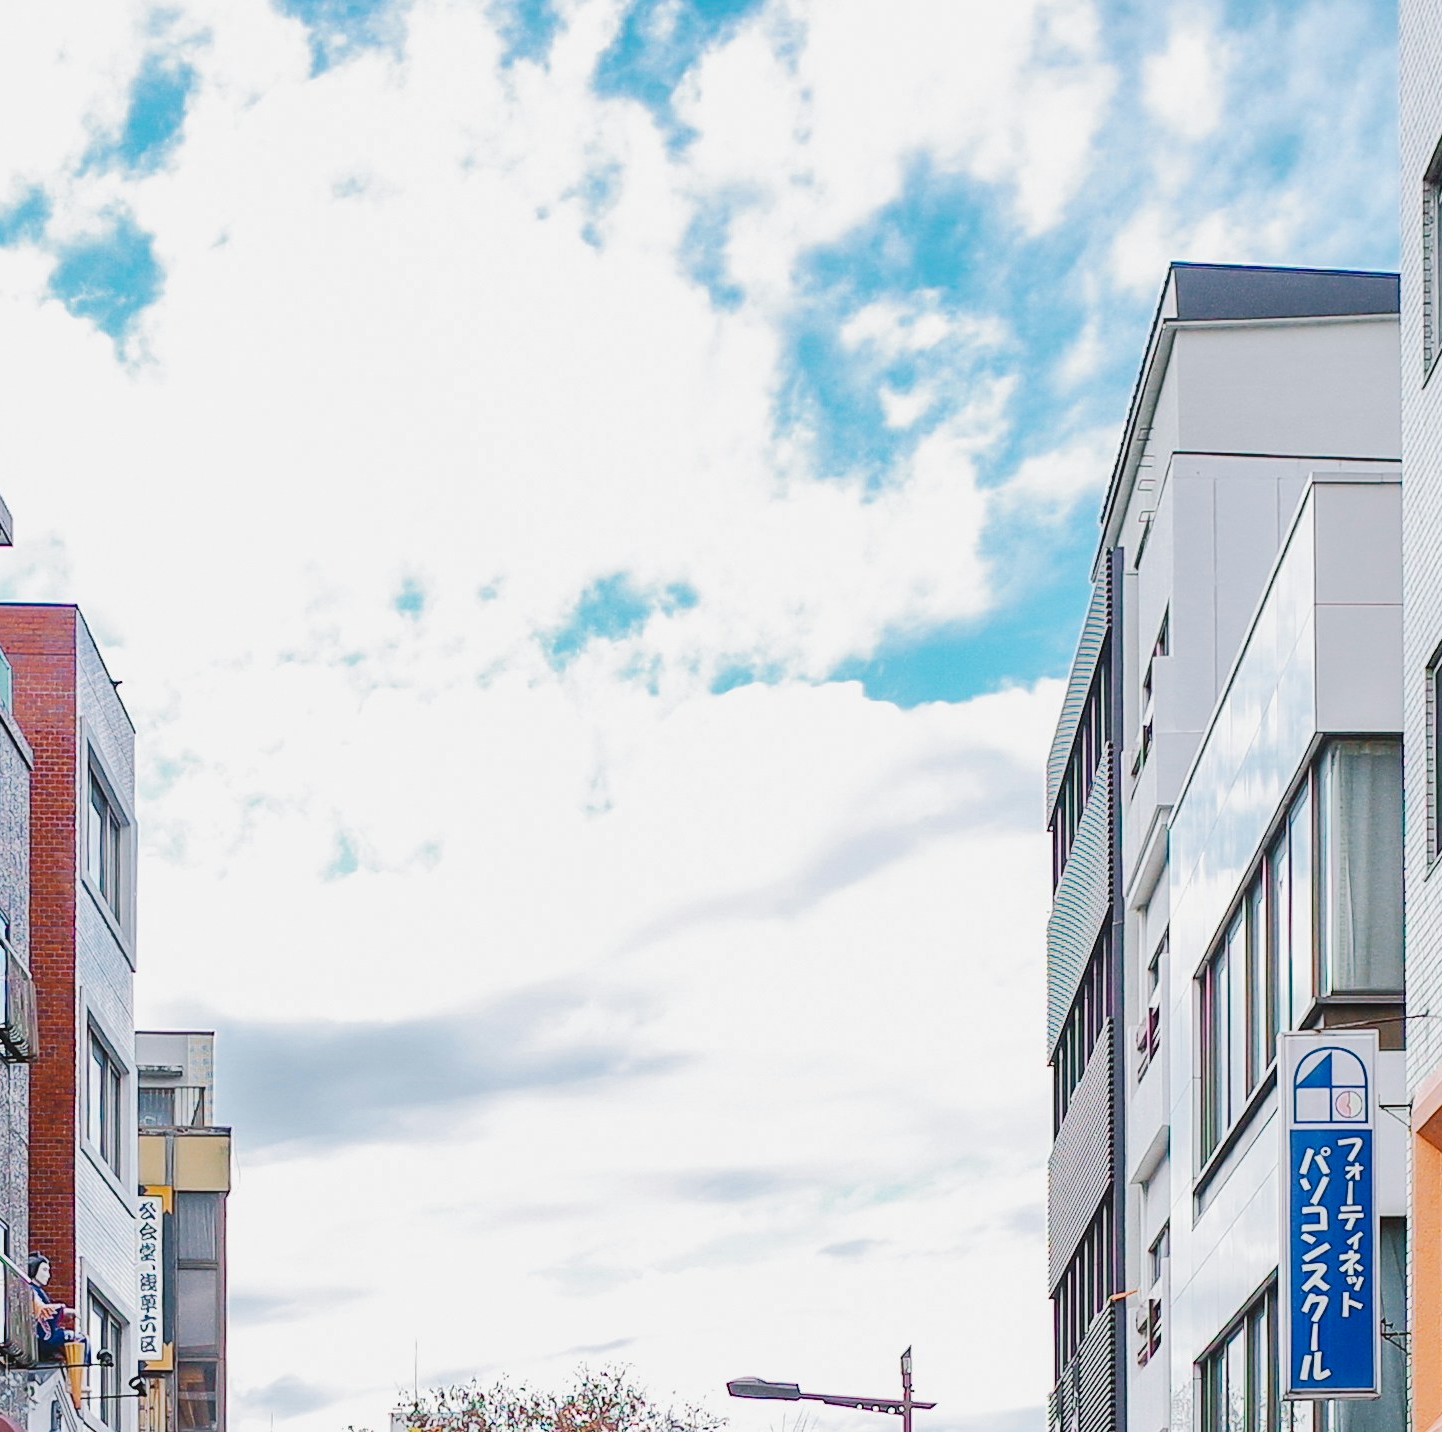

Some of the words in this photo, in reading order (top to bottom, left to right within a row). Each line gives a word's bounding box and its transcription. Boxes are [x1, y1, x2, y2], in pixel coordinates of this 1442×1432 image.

[1298, 1146, 1332, 1382] パソコンスクール
[1337, 1136, 1365, 1319] フォーティネット
